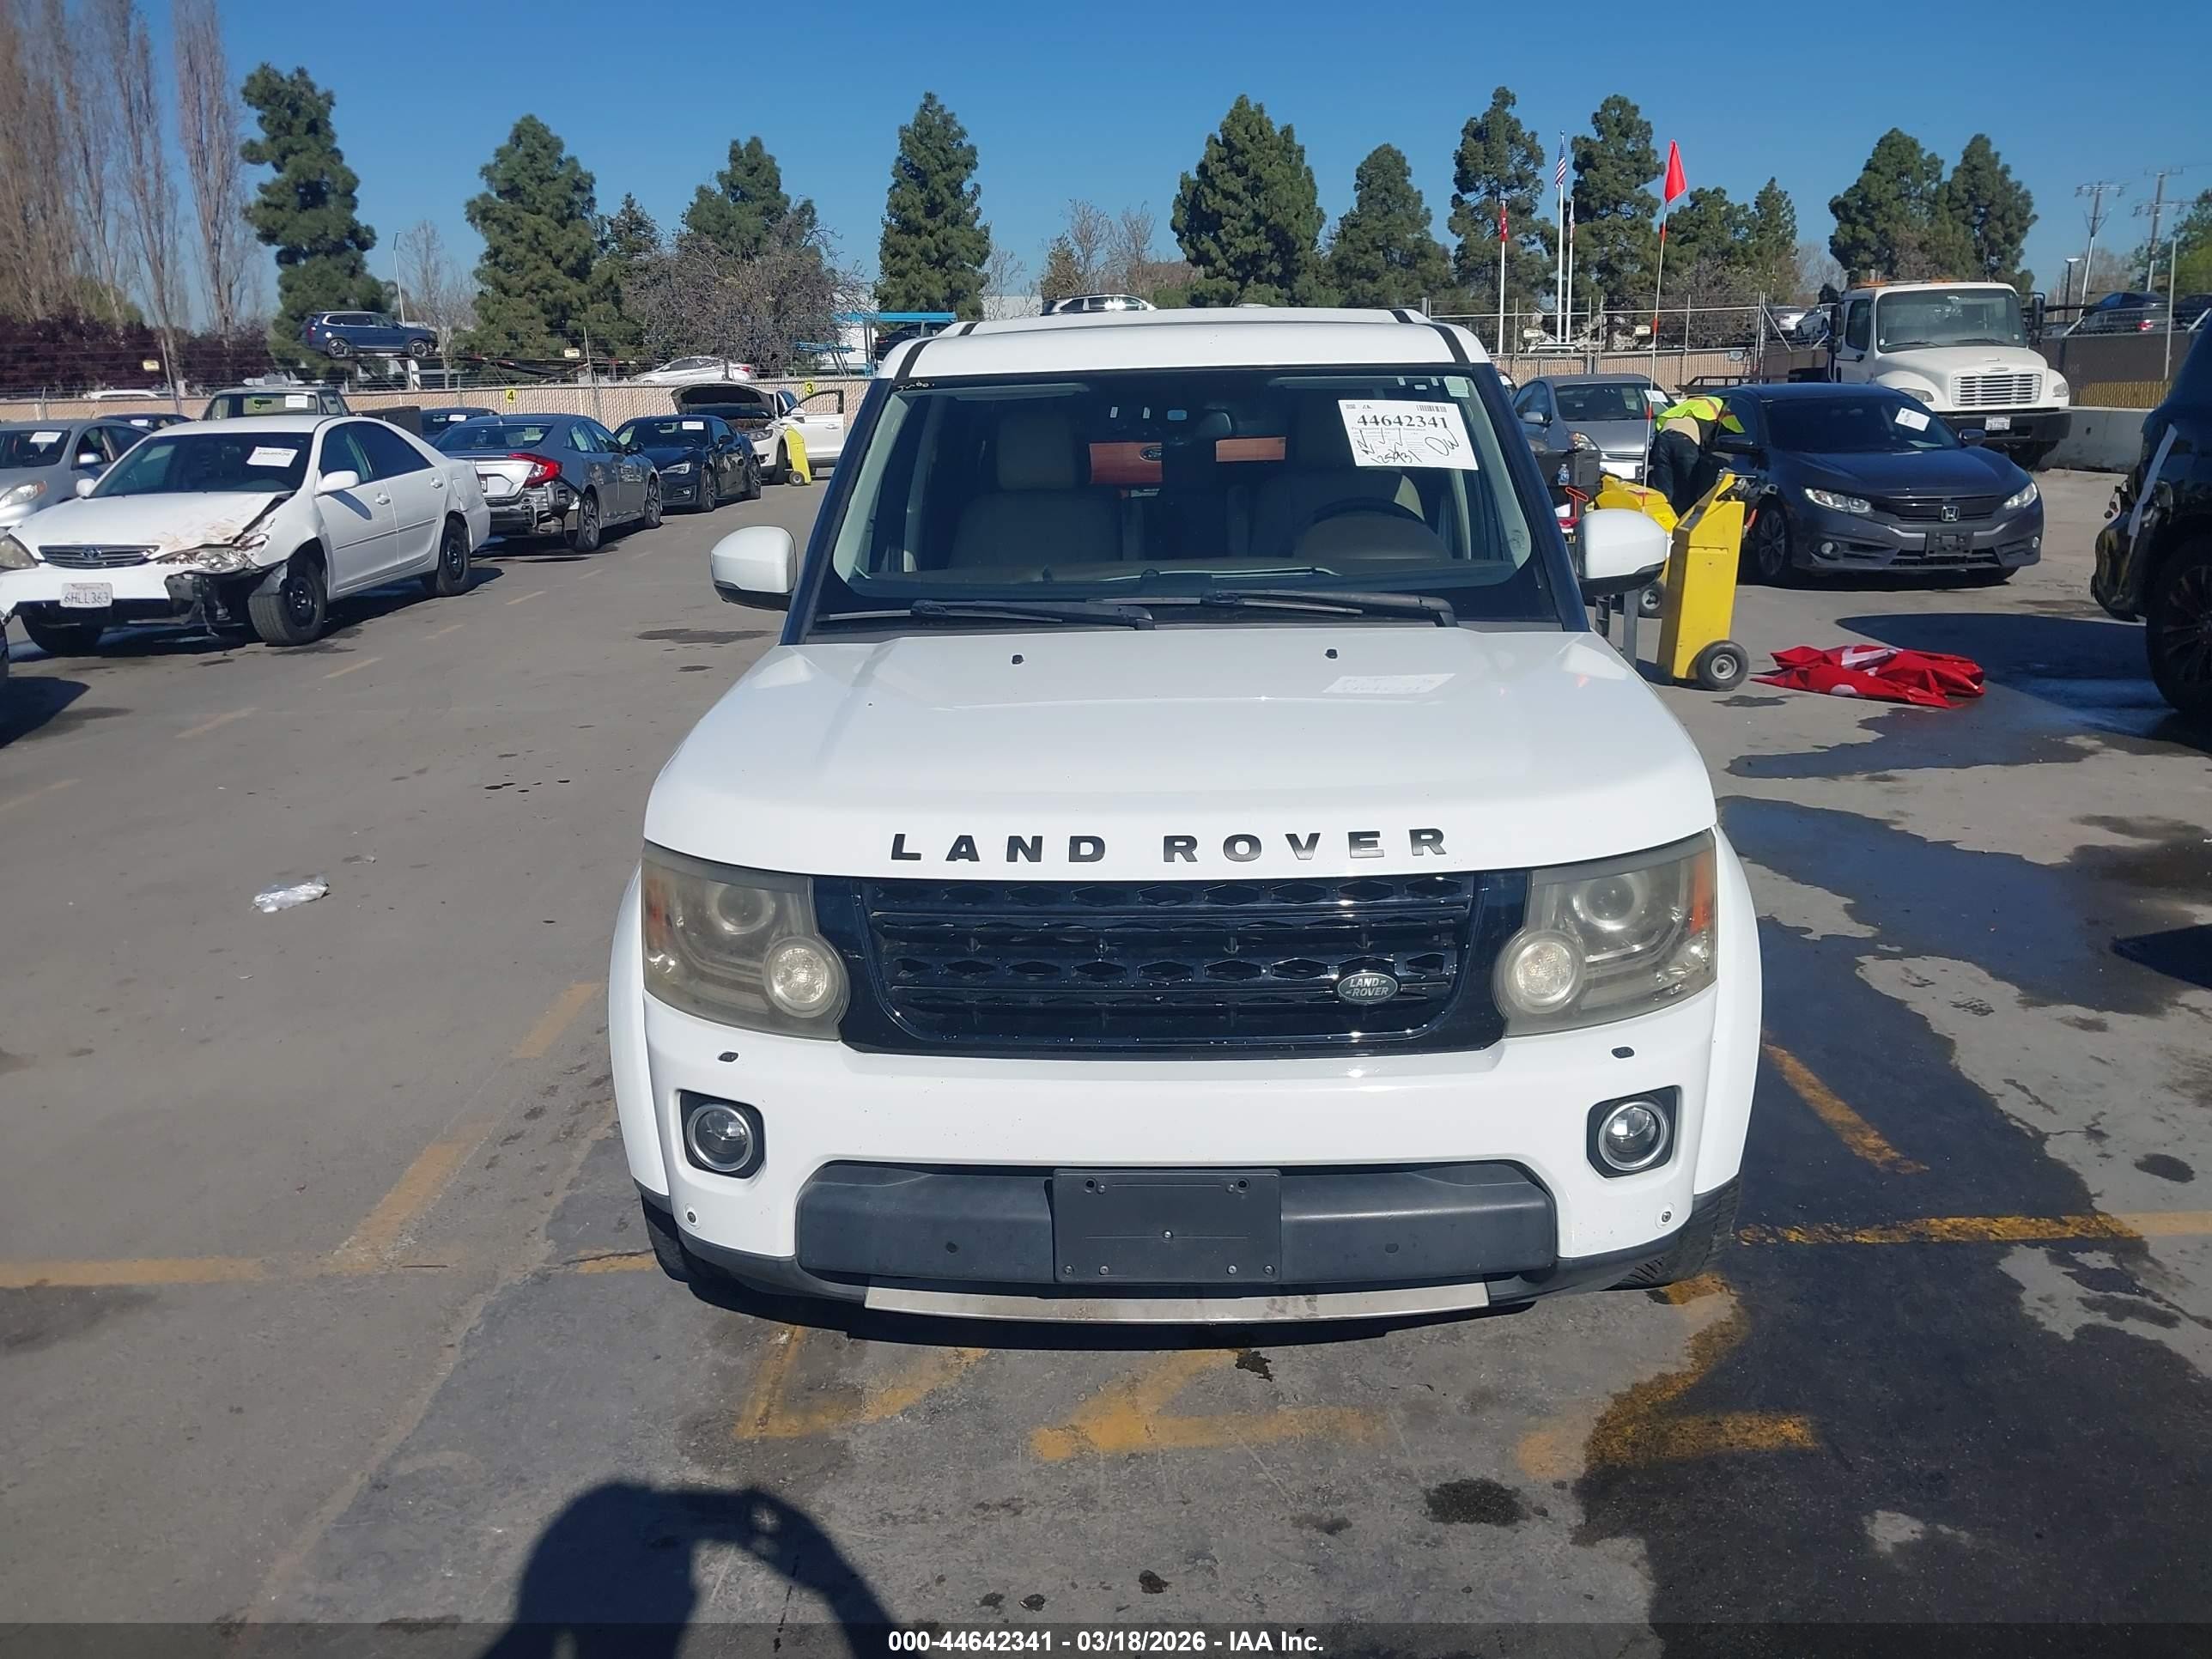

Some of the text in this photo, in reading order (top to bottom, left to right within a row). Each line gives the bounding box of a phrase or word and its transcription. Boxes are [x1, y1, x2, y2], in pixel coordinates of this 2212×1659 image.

[806, 383, 813, 394] 3
[507, 391, 514, 401] 4
[1357, 414, 1448, 428] 44642341
[890, 828, 1447, 863] LAND ROVER
[1349, 977, 1380, 988] LAND
[1352, 987, 1389, 997] ROVER
